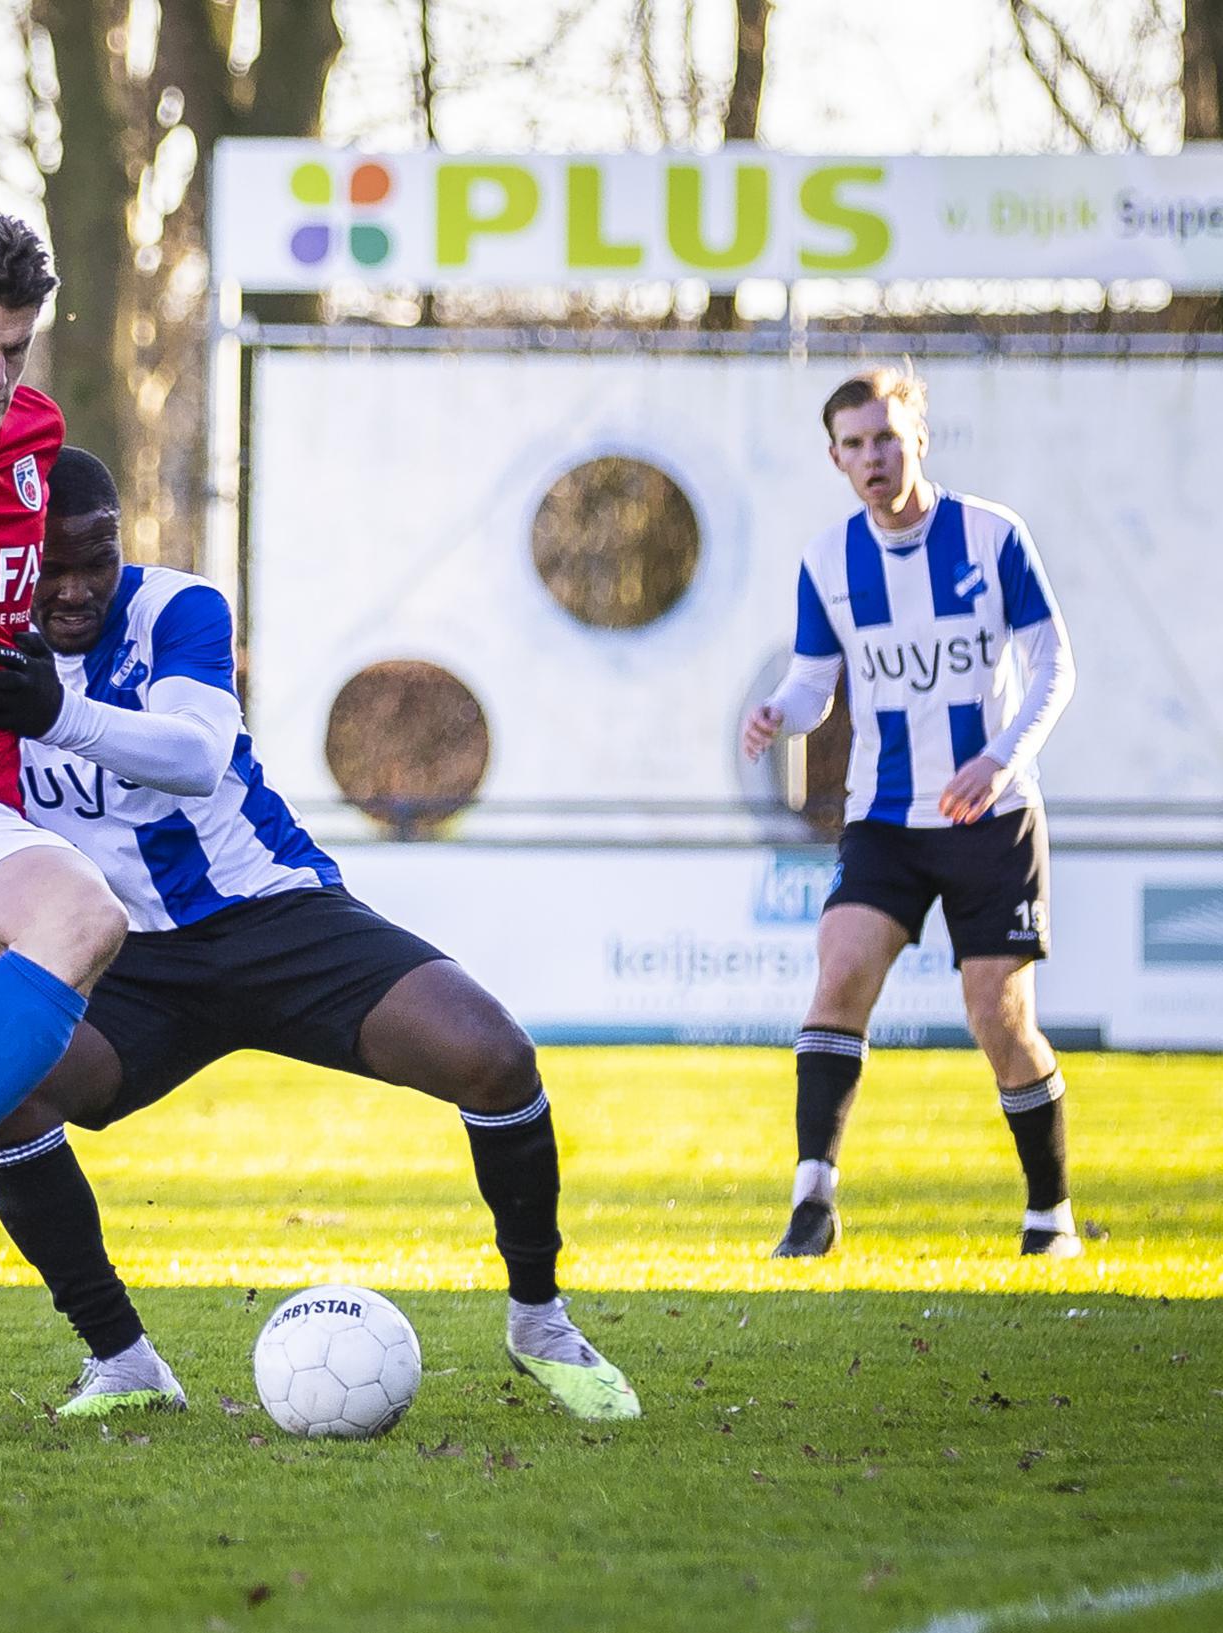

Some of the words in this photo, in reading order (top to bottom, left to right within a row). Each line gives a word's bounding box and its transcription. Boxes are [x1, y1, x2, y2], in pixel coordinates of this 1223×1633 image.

[435, 164, 891, 269] PLUS
[861, 627, 995, 692] Juyst
[18, 763, 143, 820] uy
